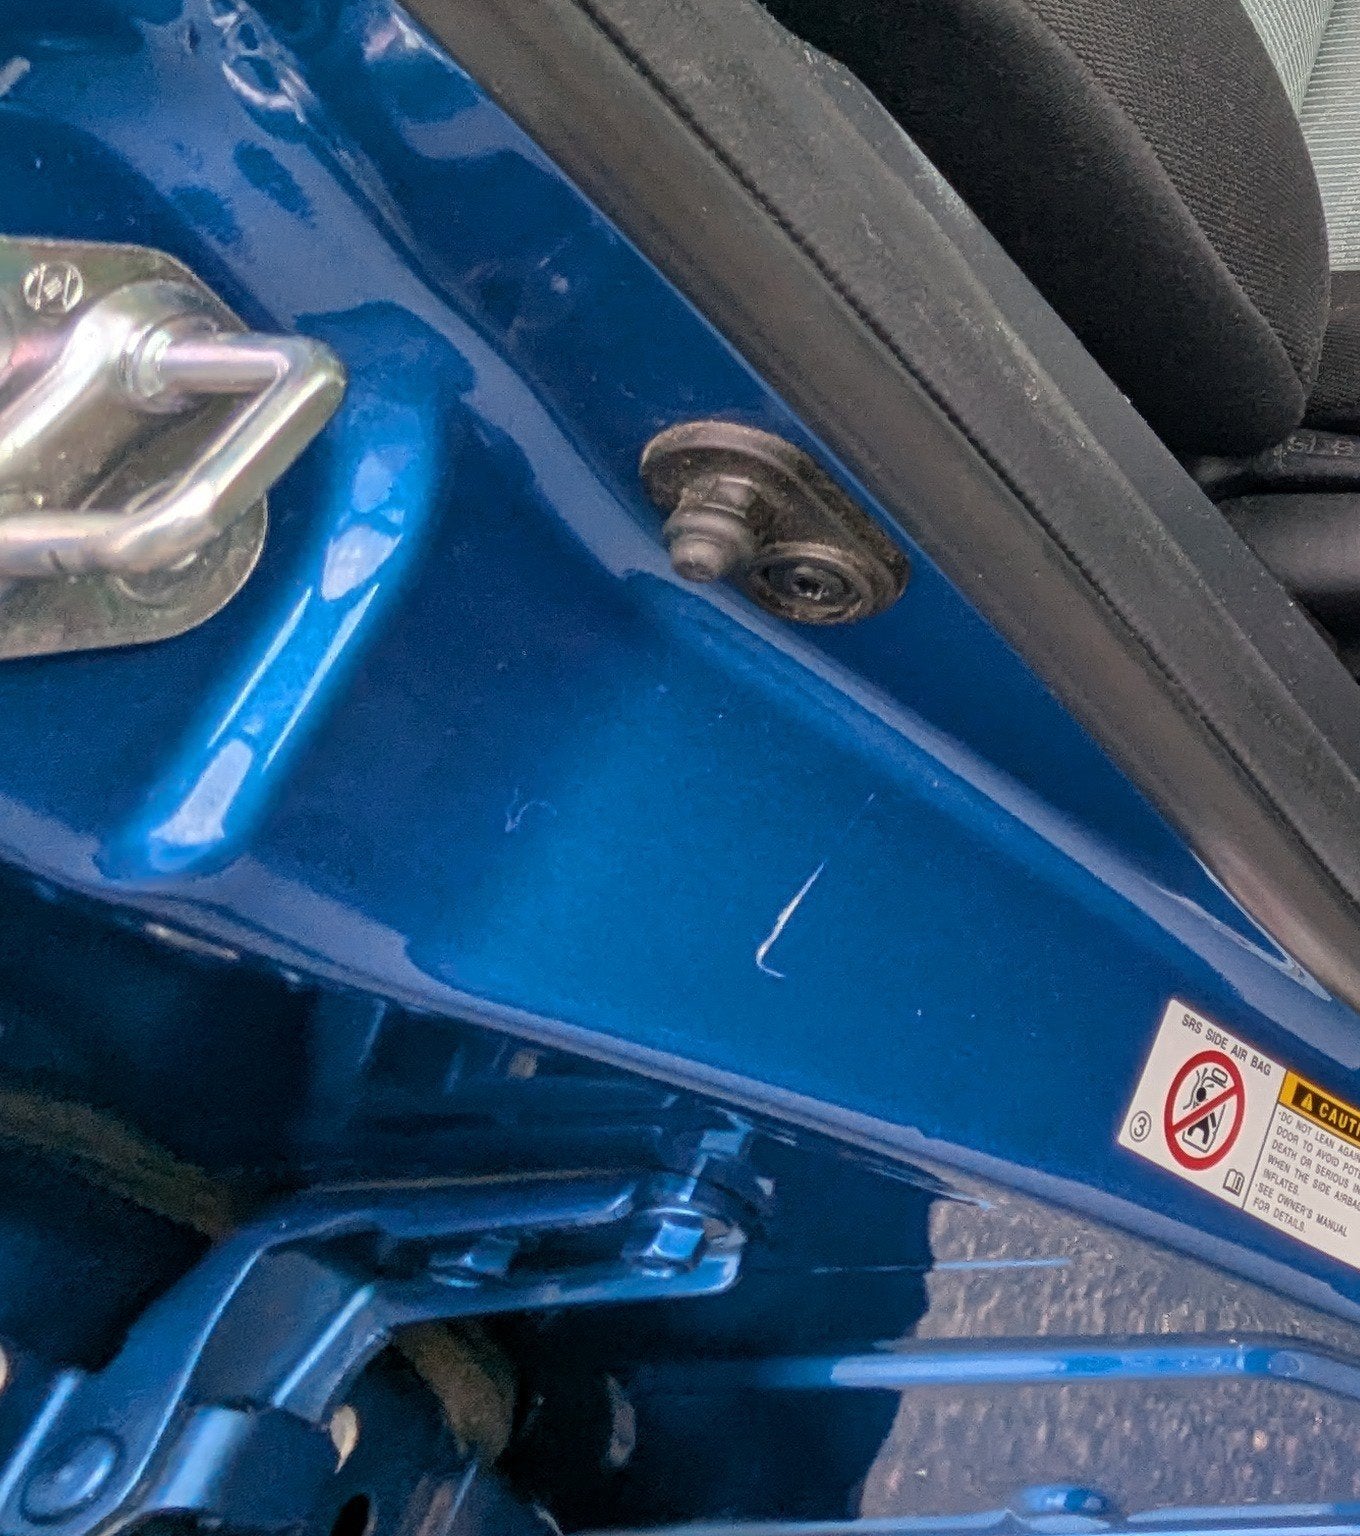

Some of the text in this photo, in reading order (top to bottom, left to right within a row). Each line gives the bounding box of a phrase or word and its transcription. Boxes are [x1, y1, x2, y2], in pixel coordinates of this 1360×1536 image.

[1182, 1014, 1271, 1076] SRS SIDE AIR BAG
[1276, 1126, 1299, 1143] DOOR
[1303, 1139, 1313, 1152] TO
[1316, 1147, 1339, 1168] AVOID
[1296, 1119, 1312, 1136] NOT
[1315, 1130, 1334, 1149] LEAN
[1268, 1154, 1290, 1173] WHEN
[1294, 1169, 1309, 1184] THE
[1312, 1179, 1331, 1196] SIDE
[1272, 1139, 1297, 1160] DEATH
[1300, 1156, 1313, 1169] OR
[1315, 1165, 1349, 1188] SERIOUS
[1253, 1197, 1306, 1233] FOR DETAILS.
[1277, 1193, 1313, 1218] OWNER'S
[1316, 1216, 1348, 1237] MANUAL
